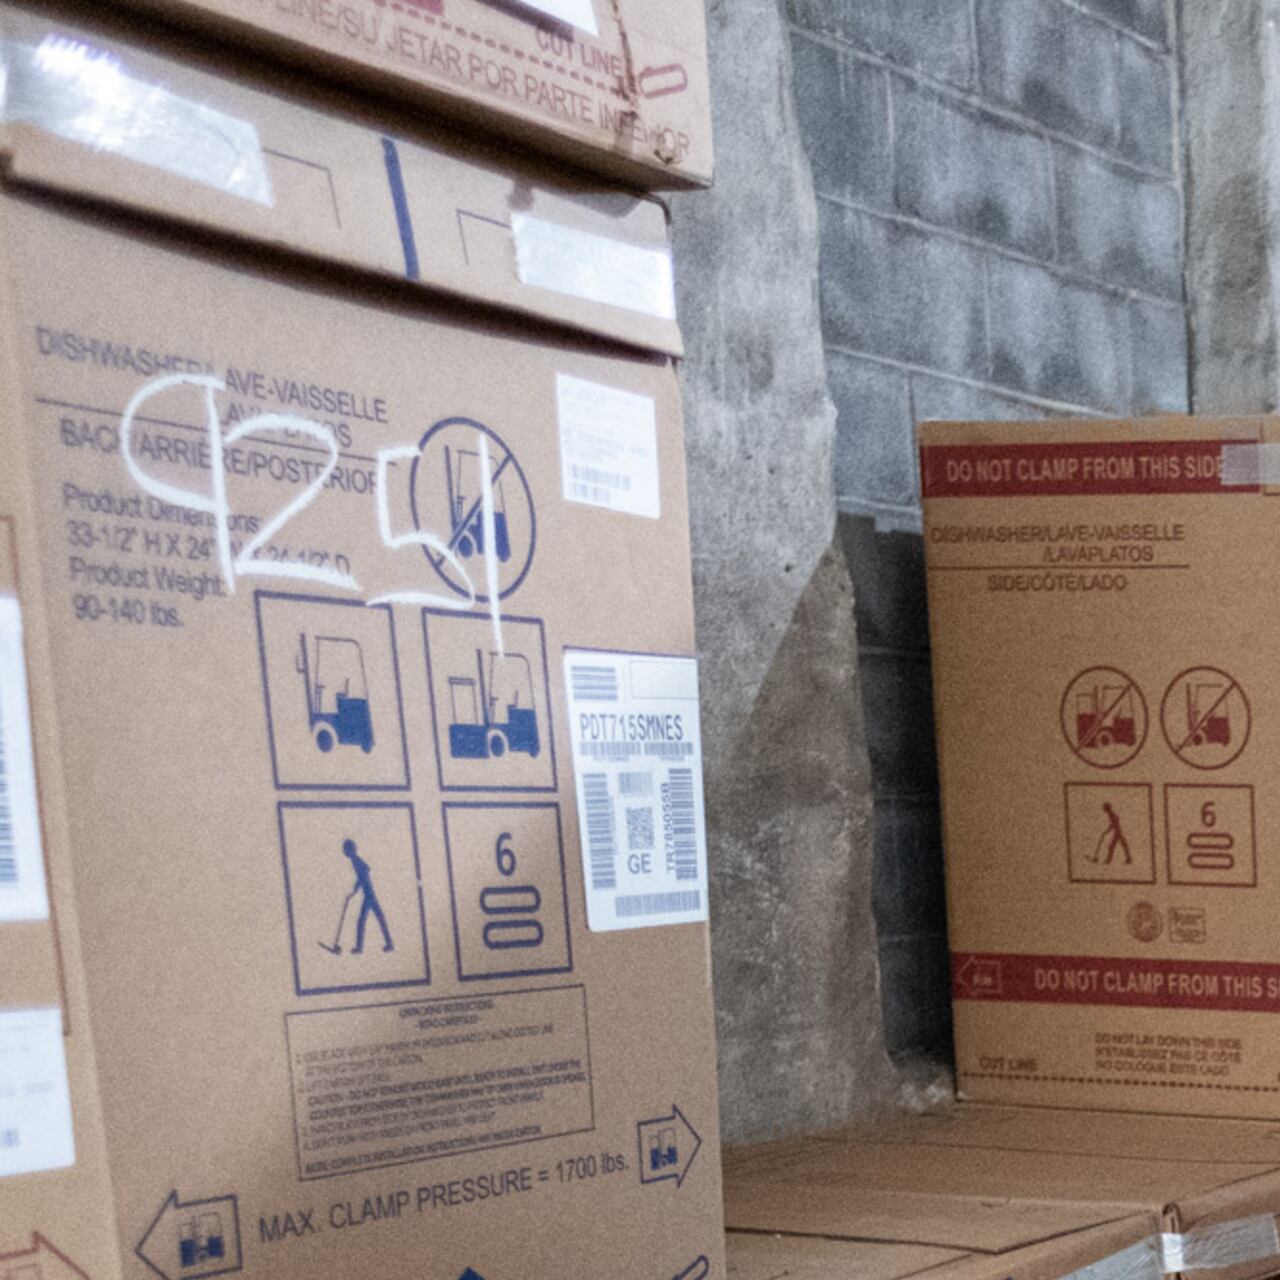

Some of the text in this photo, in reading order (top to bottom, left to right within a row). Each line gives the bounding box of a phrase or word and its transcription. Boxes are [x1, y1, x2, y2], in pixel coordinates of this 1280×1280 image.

[946, 455, 1181, 483] DO NOT CLAMP FROM THIS
[1200, 801, 1217, 829] 6
[495, 831, 517, 878] 6
[626, 853, 653, 875] GE
[1034, 968, 1061, 991] DO
[1064, 969, 1099, 992] NOT
[1103, 970, 1165, 995] CLAMP
[1167, 973, 1219, 998] FROM
[1222, 975, 1262, 999] THIS
[330, 1190, 412, 1231] CLAMP
[415, 1165, 534, 1214] PRESSURE
[556, 1154, 600, 1185] 1700
